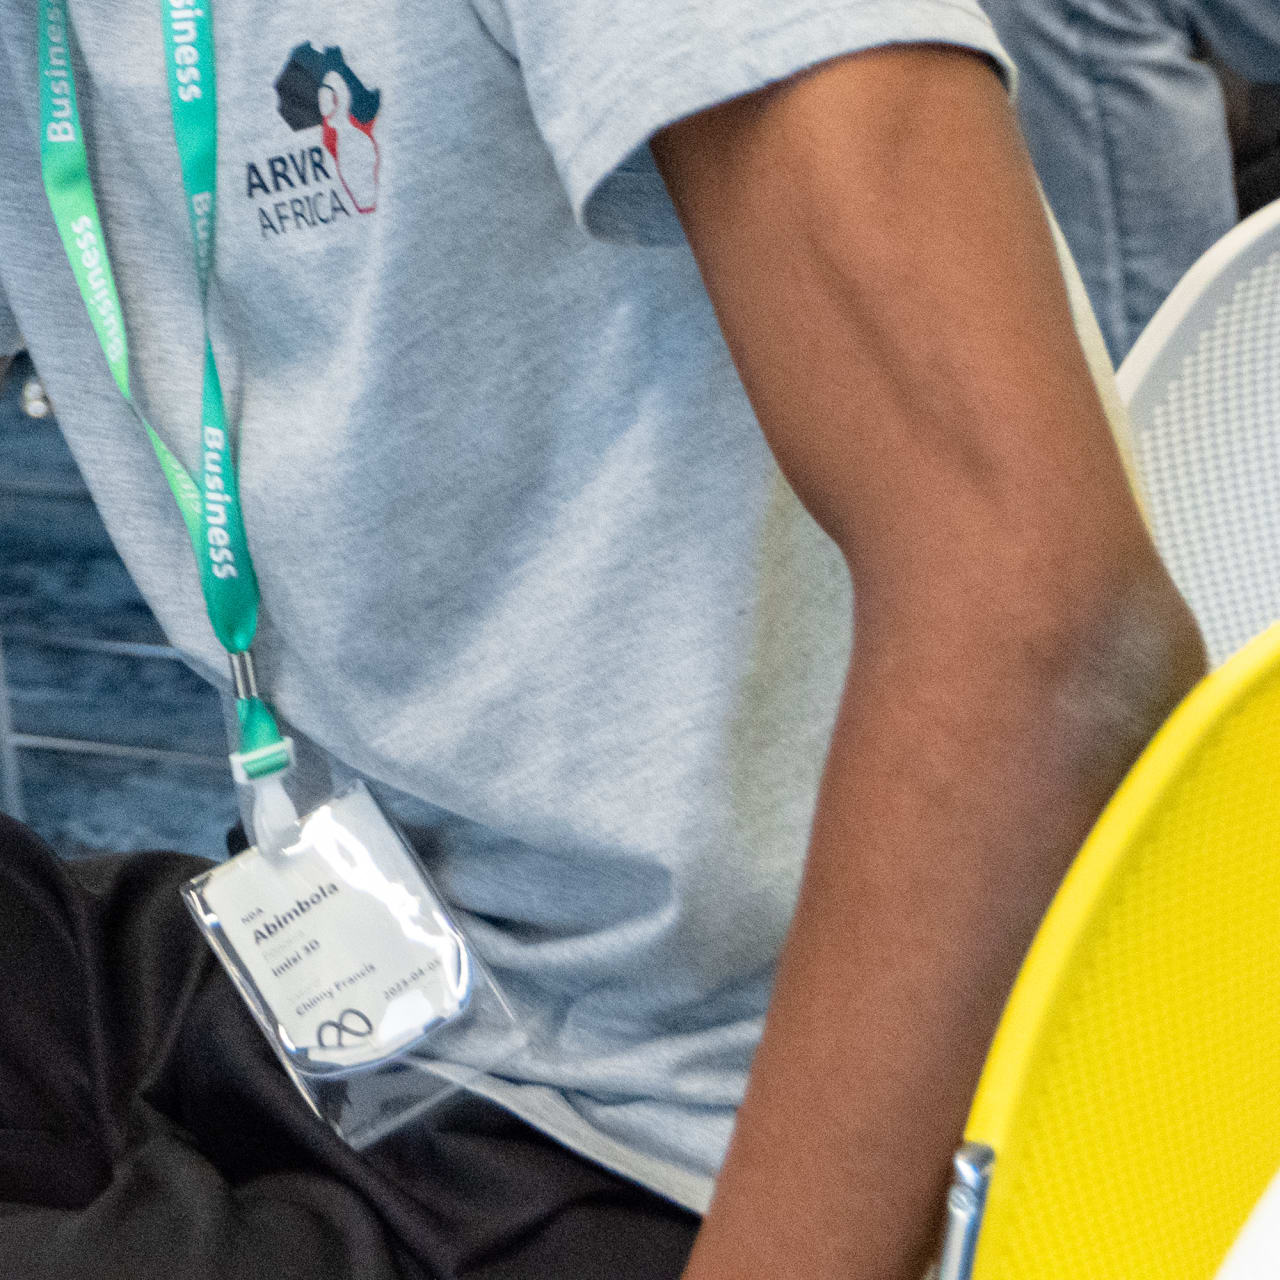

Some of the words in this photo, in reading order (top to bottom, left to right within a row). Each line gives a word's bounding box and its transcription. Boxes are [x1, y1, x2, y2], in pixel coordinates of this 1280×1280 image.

[245, 145, 331, 198] ARVR
[259, 188, 351, 239] AFRICA
[203, 426, 238, 580] Business
[253, 881, 340, 945] Abimbola
